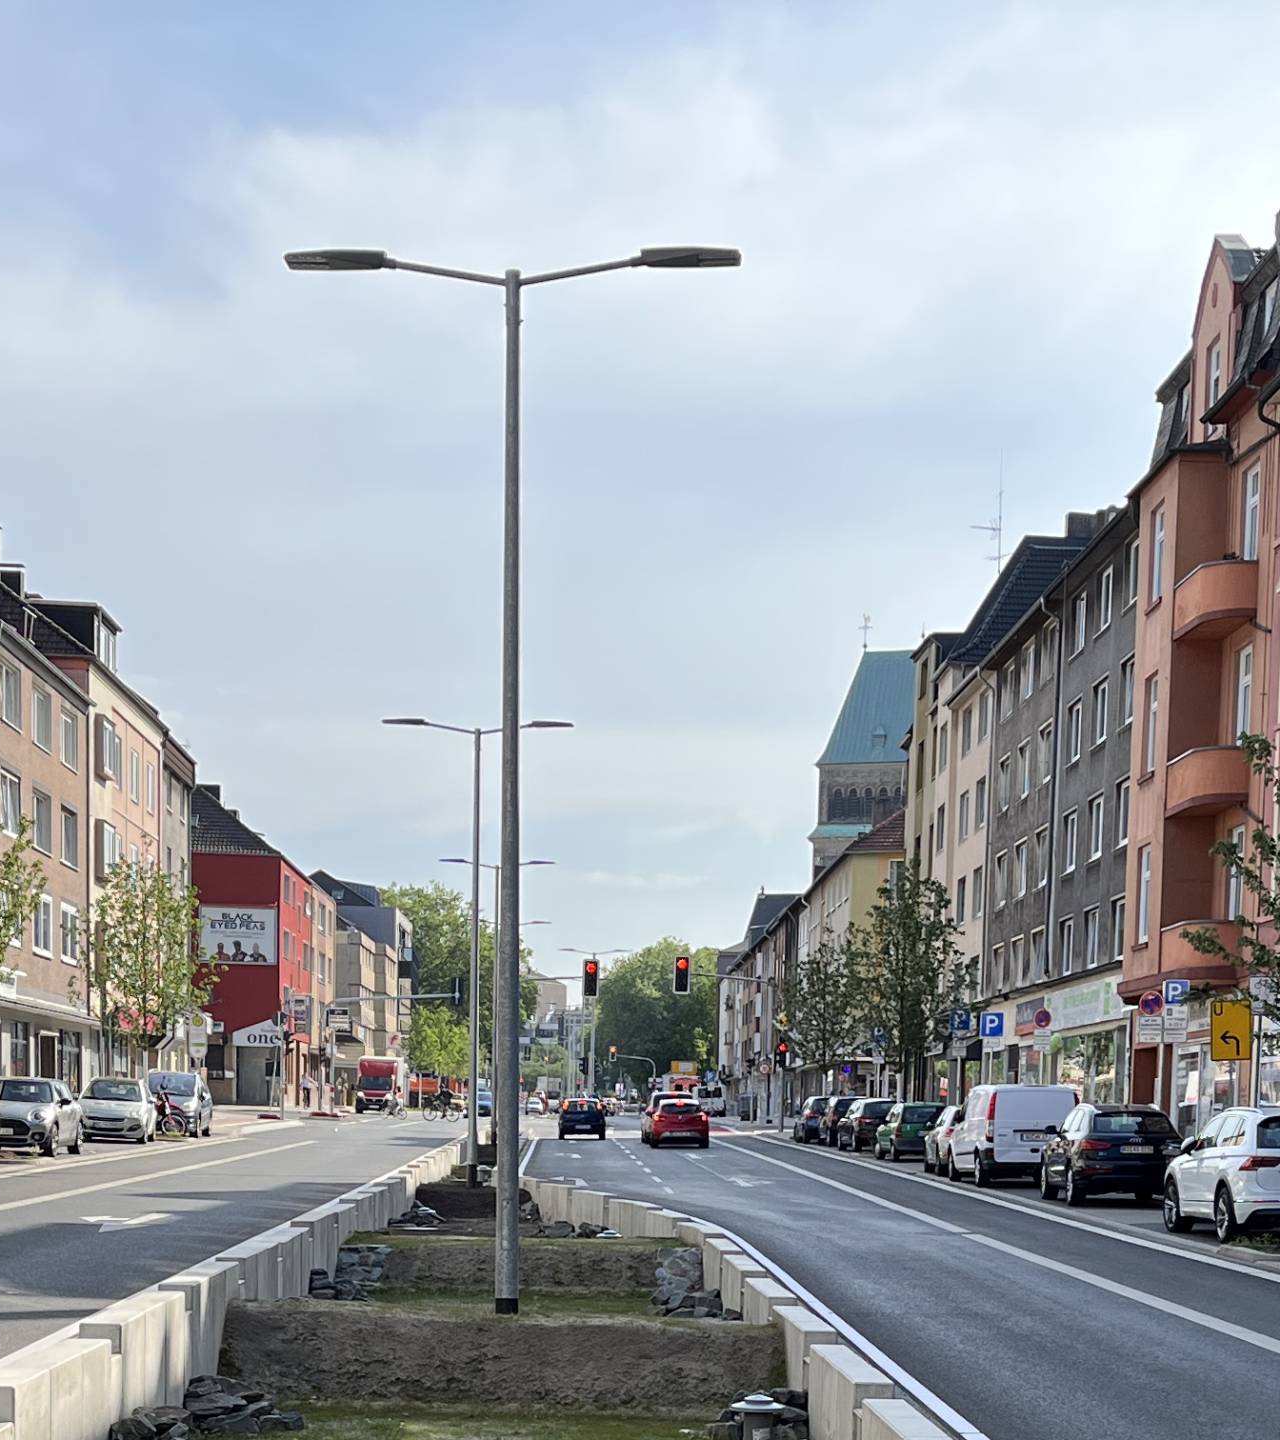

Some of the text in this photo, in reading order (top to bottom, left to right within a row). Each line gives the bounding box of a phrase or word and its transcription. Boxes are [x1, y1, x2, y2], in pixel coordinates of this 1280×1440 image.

[221, 912, 253, 921] BLACK
[210, 921, 266, 930] EYED PEAS
[985, 1015, 999, 1034] P
